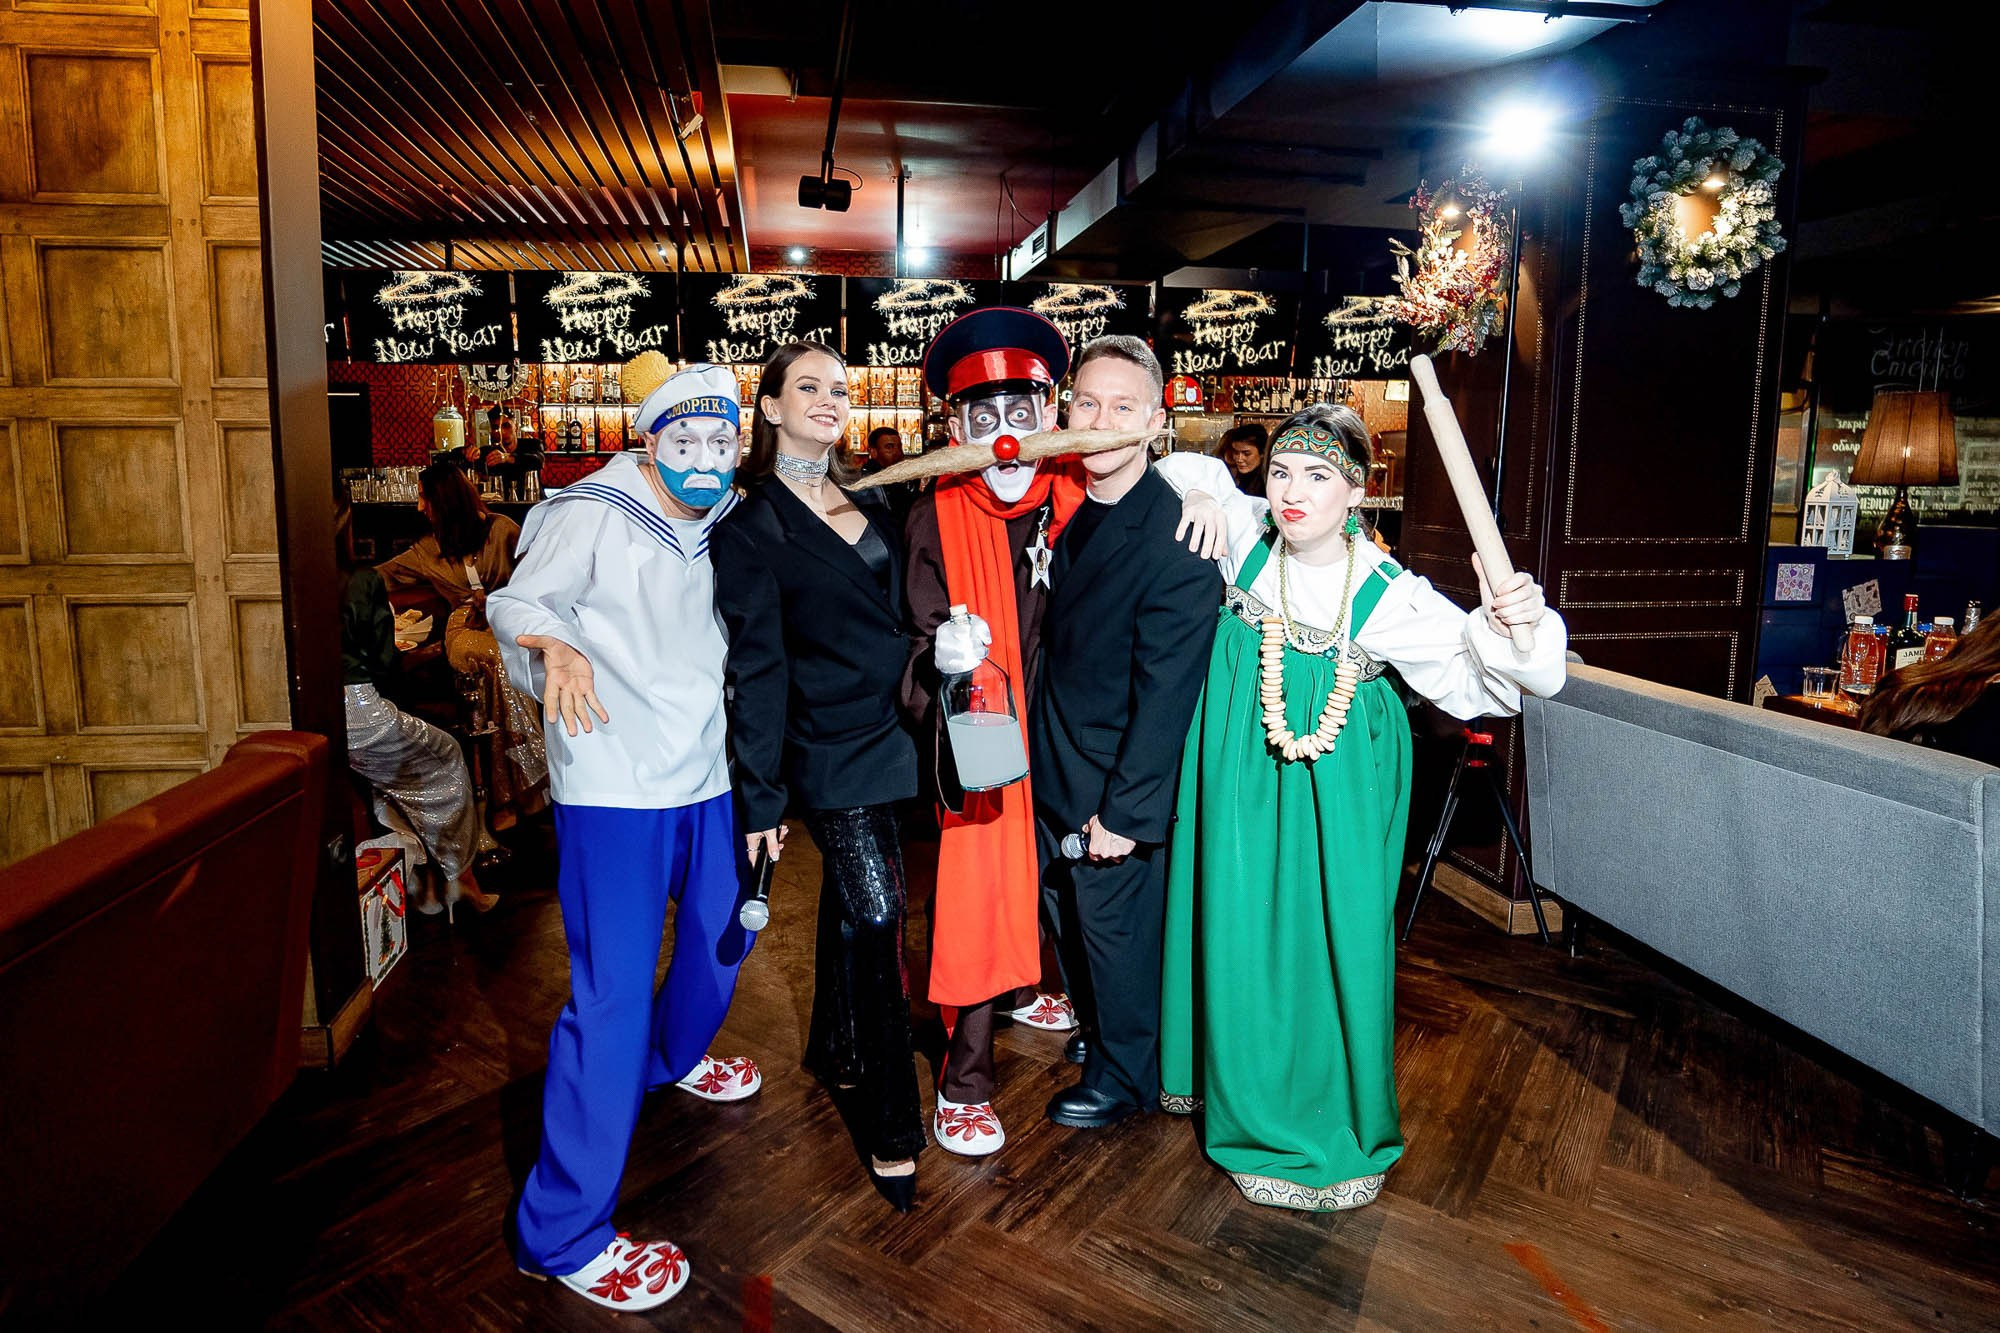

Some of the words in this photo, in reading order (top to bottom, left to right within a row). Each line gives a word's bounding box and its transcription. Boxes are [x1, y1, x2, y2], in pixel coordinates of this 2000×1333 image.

[392, 304, 467, 333] Happy
[559, 304, 635, 334] Happy
[727, 307, 799, 336] Happy
[374, 337, 434, 362] New
[440, 324, 502, 353] Year
[541, 337, 601, 362] New
[606, 325, 668, 356] Year
[1192, 321, 1259, 347] Happy
[1331, 327, 1396, 353] Happy
[706, 338, 765, 363] New
[866, 342, 924, 366] New
[1172, 350, 1226, 373] New
[1232, 340, 1286, 367] Year
[1313, 356, 1364, 377] New
[1370, 346, 1411, 373] Yea
[671, 398, 722, 417] МОРЯК
[1903, 650, 1925, 658] JAME
